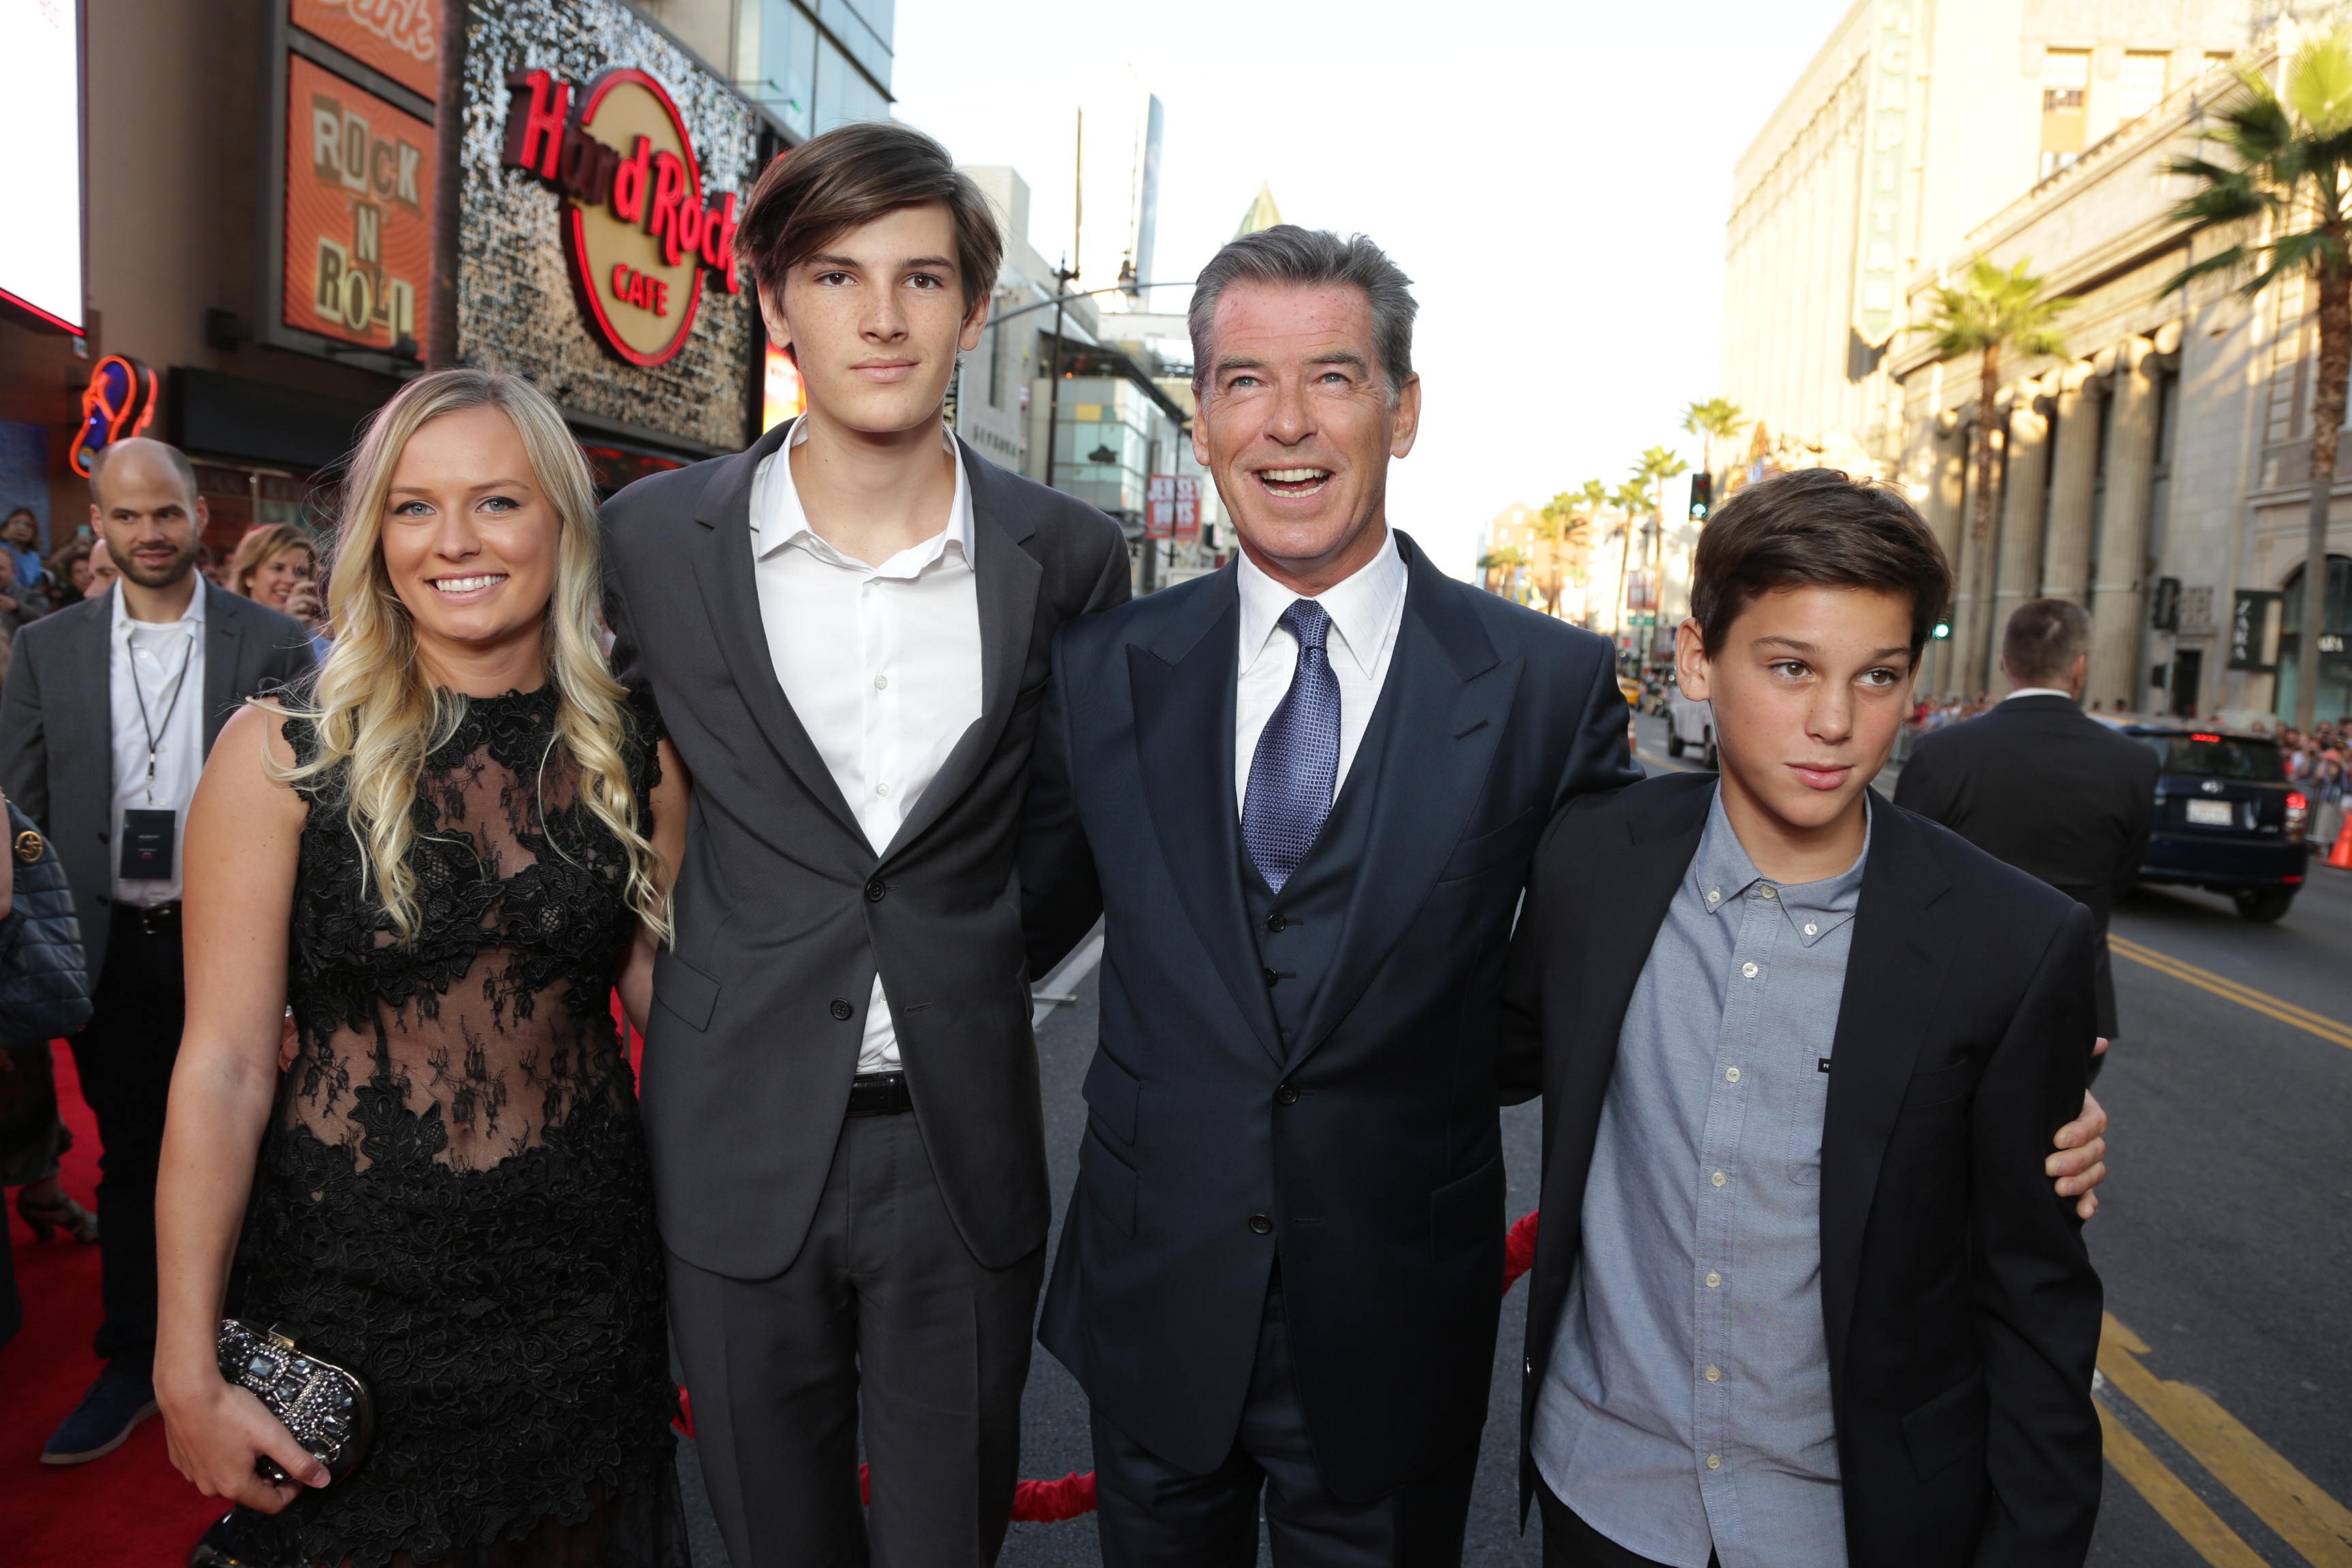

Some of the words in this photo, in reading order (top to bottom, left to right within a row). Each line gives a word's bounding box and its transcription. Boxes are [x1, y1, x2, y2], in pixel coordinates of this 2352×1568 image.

[314, 107, 421, 205] ROCK
[519, 67, 651, 224] Hard
[650, 150, 740, 295] Rock
[613, 263, 669, 317] CAFE
[2234, 599, 2252, 661] ZARA
